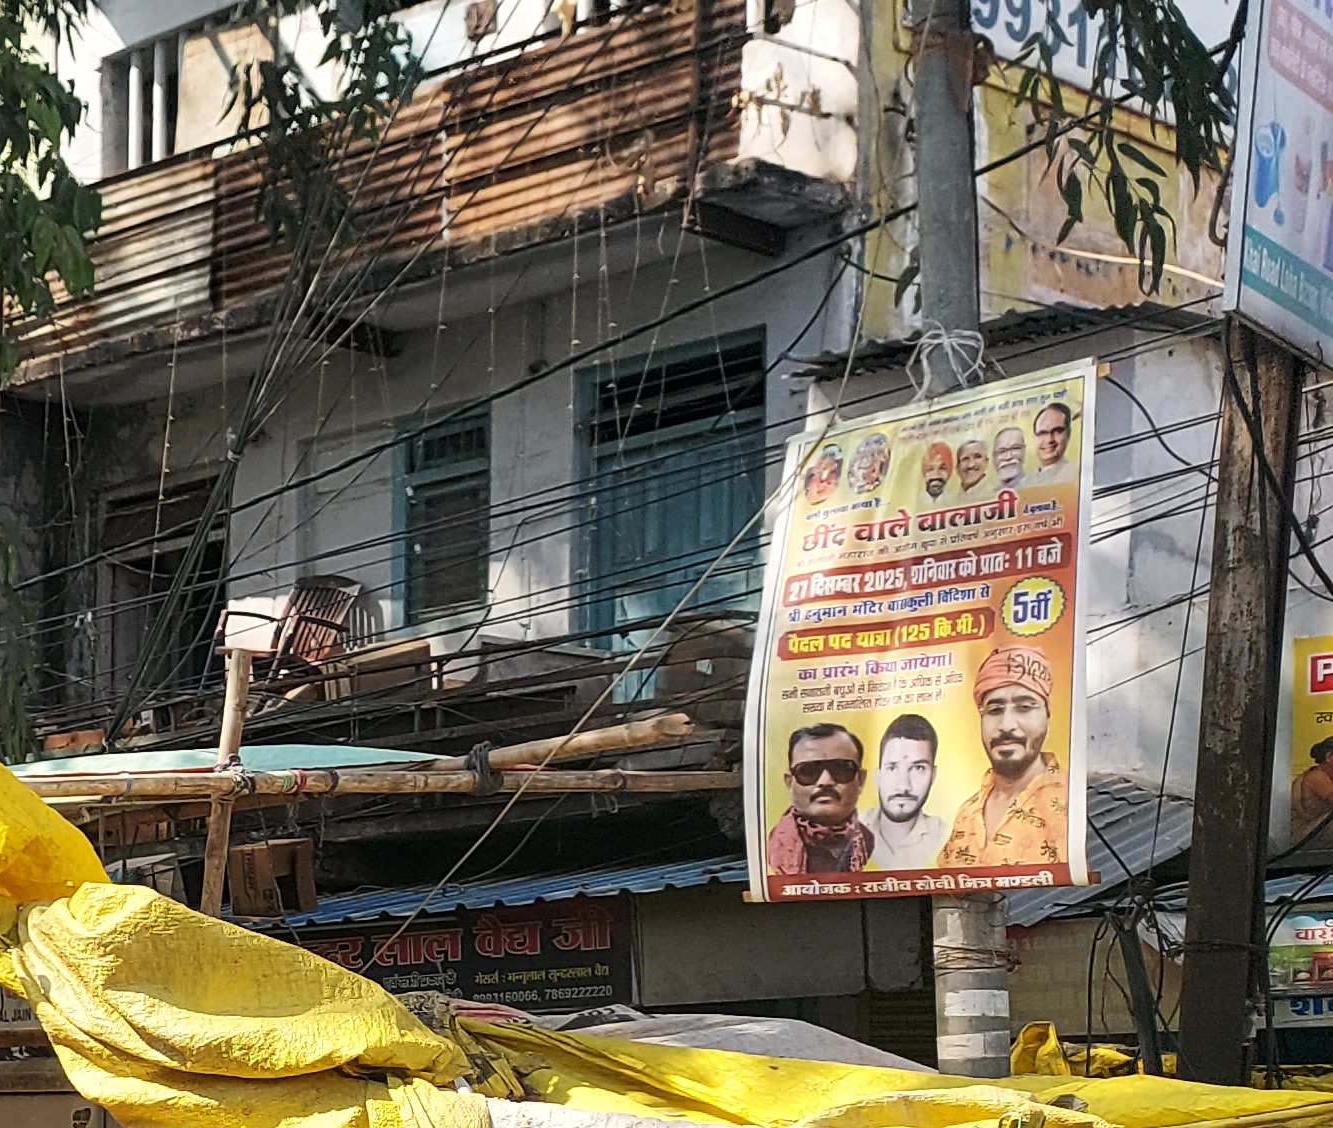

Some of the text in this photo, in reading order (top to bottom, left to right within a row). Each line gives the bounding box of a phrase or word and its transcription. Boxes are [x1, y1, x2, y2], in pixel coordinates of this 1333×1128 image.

[854, 511, 912, 542] वाले
[918, 489, 1018, 532] बालाजी
[789, 578, 809, 599] 27
[810, 571, 860, 595] दिसम्बर
[864, 568, 907, 592] 2025,
[911, 559, 956, 584] शनिवार
[959, 552, 975, 576] को
[1015, 547, 1034, 570] 11
[1036, 536, 1063, 565] बजे
[804, 605, 846, 624] हनुमान
[937, 586, 976, 605] विदिशा
[981, 583, 990, 599] से
[788, 632, 824, 654] पैदल
[828, 631, 852, 650] पद
[857, 627, 891, 648] यात्रा
[894, 621, 931, 648] (125
[797, 667, 818, 681] का
[822, 661, 859, 680] प्रारंभ
[865, 657, 897, 676] किया
[781, 879, 851, 897] आयोजक
[863, 876, 912, 893] राजीव
[915, 873, 956, 891] सोनी
[995, 871, 1054, 887] मण्डली
[371, 904, 612, 966] लाल वैद्य जी
